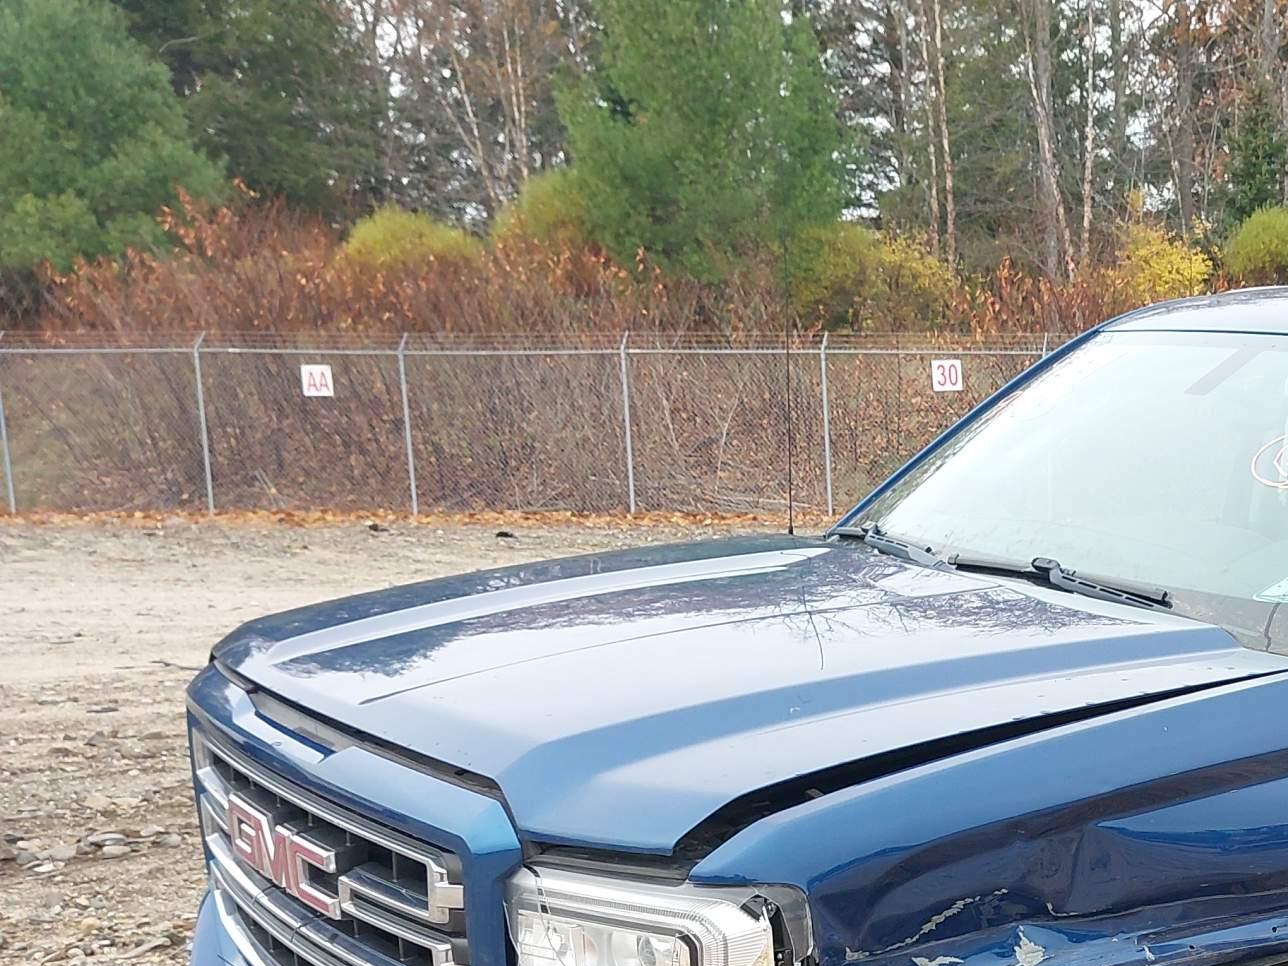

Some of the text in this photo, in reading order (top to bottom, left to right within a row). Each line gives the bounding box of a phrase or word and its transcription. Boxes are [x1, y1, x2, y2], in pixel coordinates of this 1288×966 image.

[307, 371, 330, 393] AA
[936, 363, 959, 387] 30
[228, 792, 342, 921] GMC
